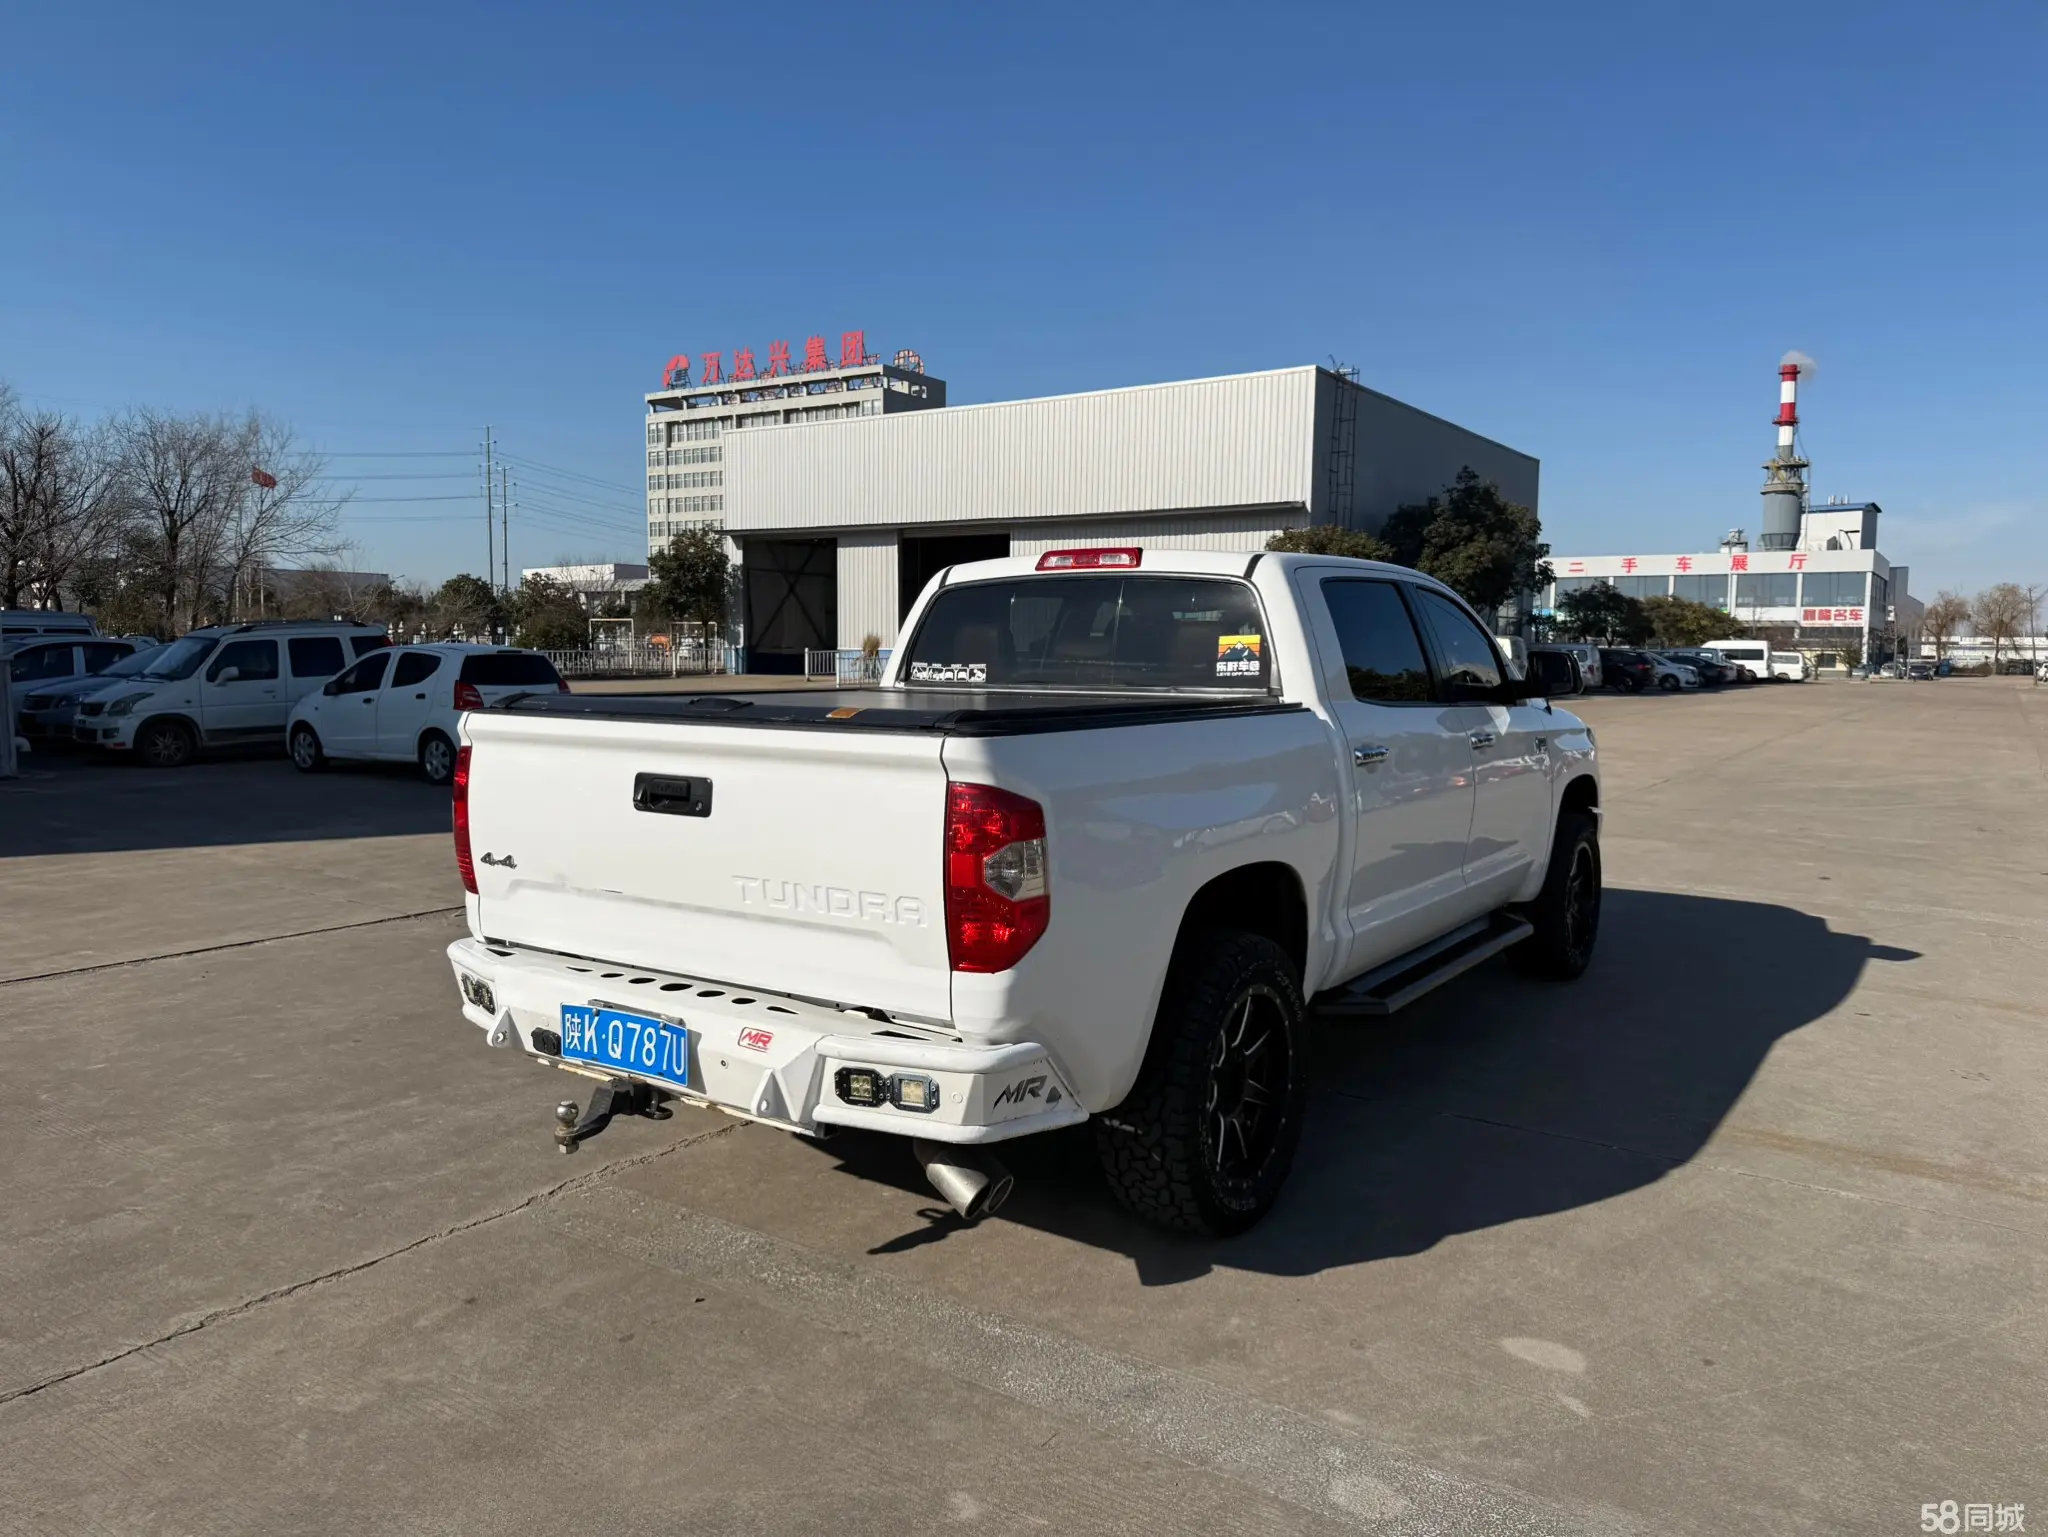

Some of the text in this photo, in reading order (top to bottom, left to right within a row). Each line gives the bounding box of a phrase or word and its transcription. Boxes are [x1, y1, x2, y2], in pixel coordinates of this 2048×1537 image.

[702, 329, 863, 384] 万达兴集团
[1568, 553, 1808, 574] 二手车展厅
[731, 874, 928, 928] TUNDRA
[741, 1030, 773, 1048] MR
[992, 1074, 1048, 1111] MR
